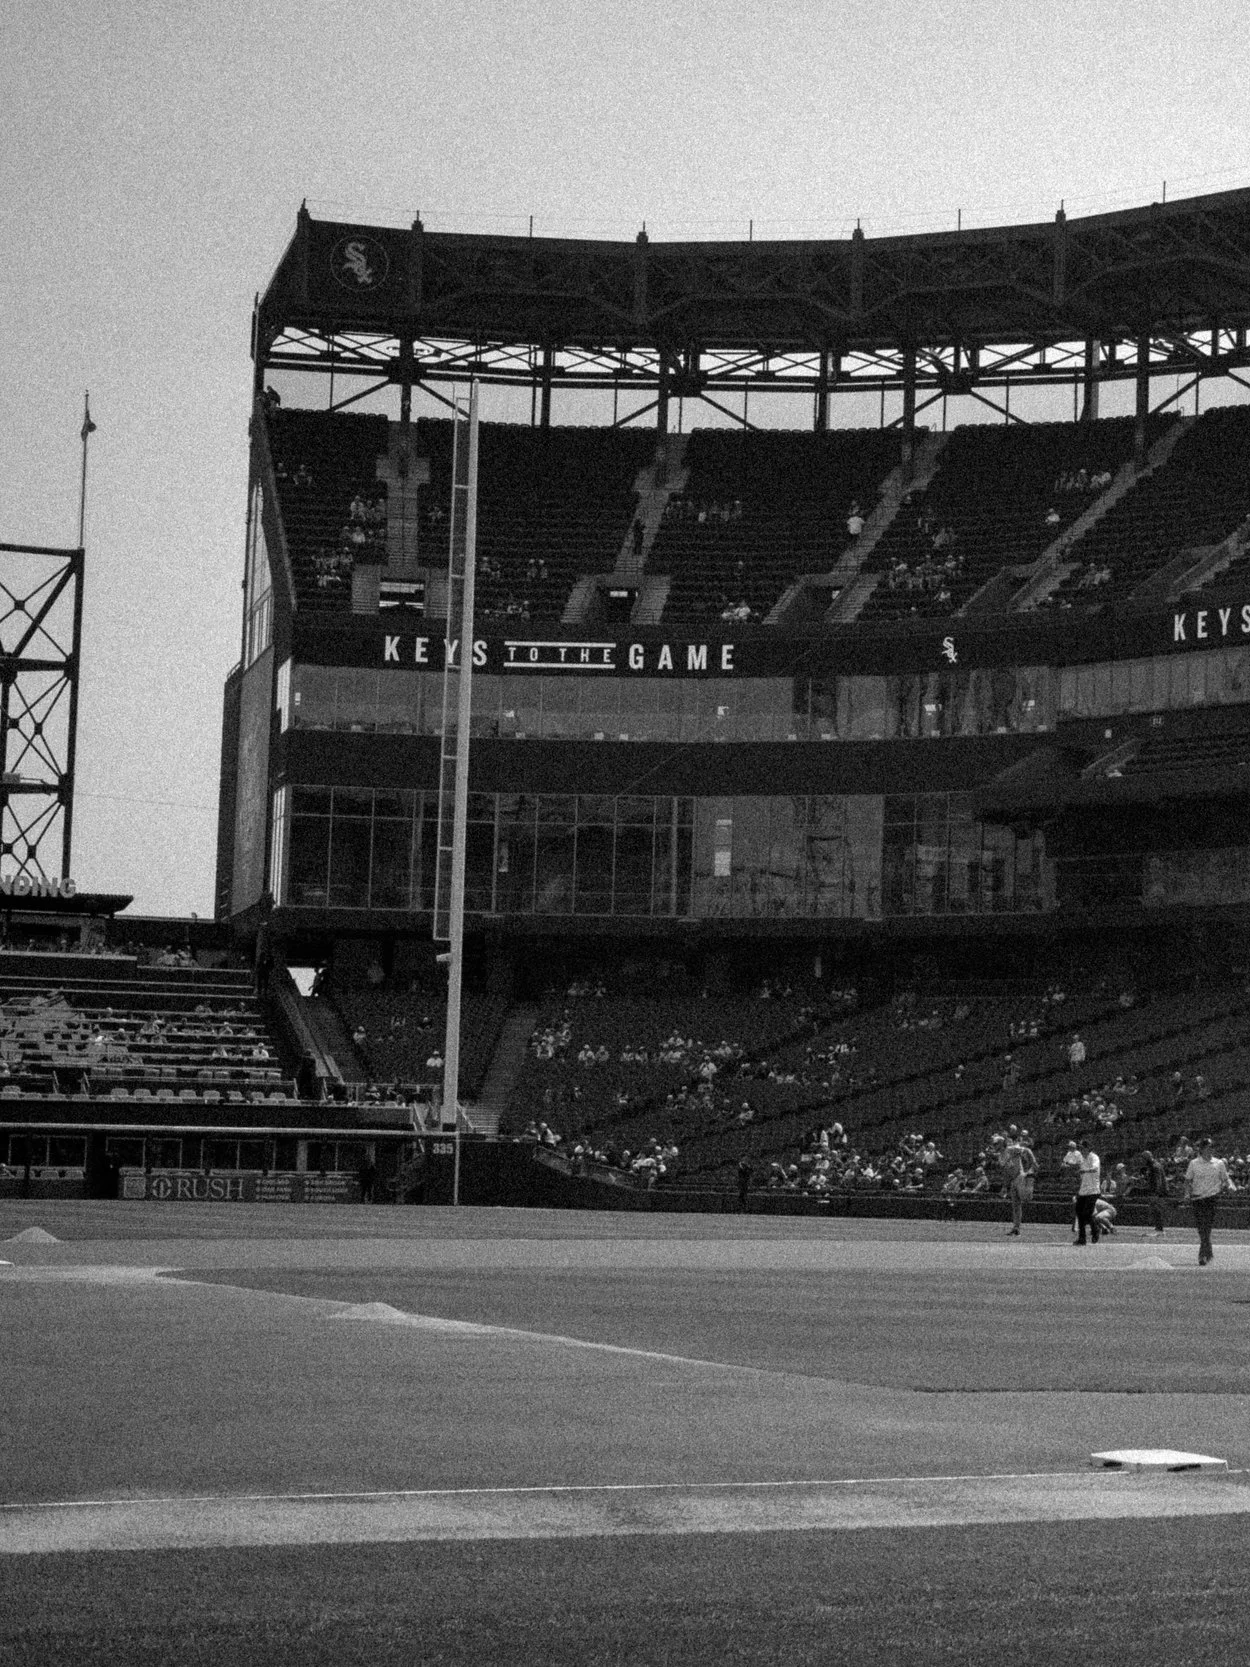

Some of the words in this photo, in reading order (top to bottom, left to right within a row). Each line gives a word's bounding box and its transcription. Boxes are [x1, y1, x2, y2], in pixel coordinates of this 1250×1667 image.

[384, 636, 488, 666] KEYS
[508, 647, 539, 661] TO
[560, 647, 611, 662] THE
[629, 643, 734, 670] GAME
[432, 1143, 454, 1154] 335
[176, 1178, 244, 1199] RUSH
